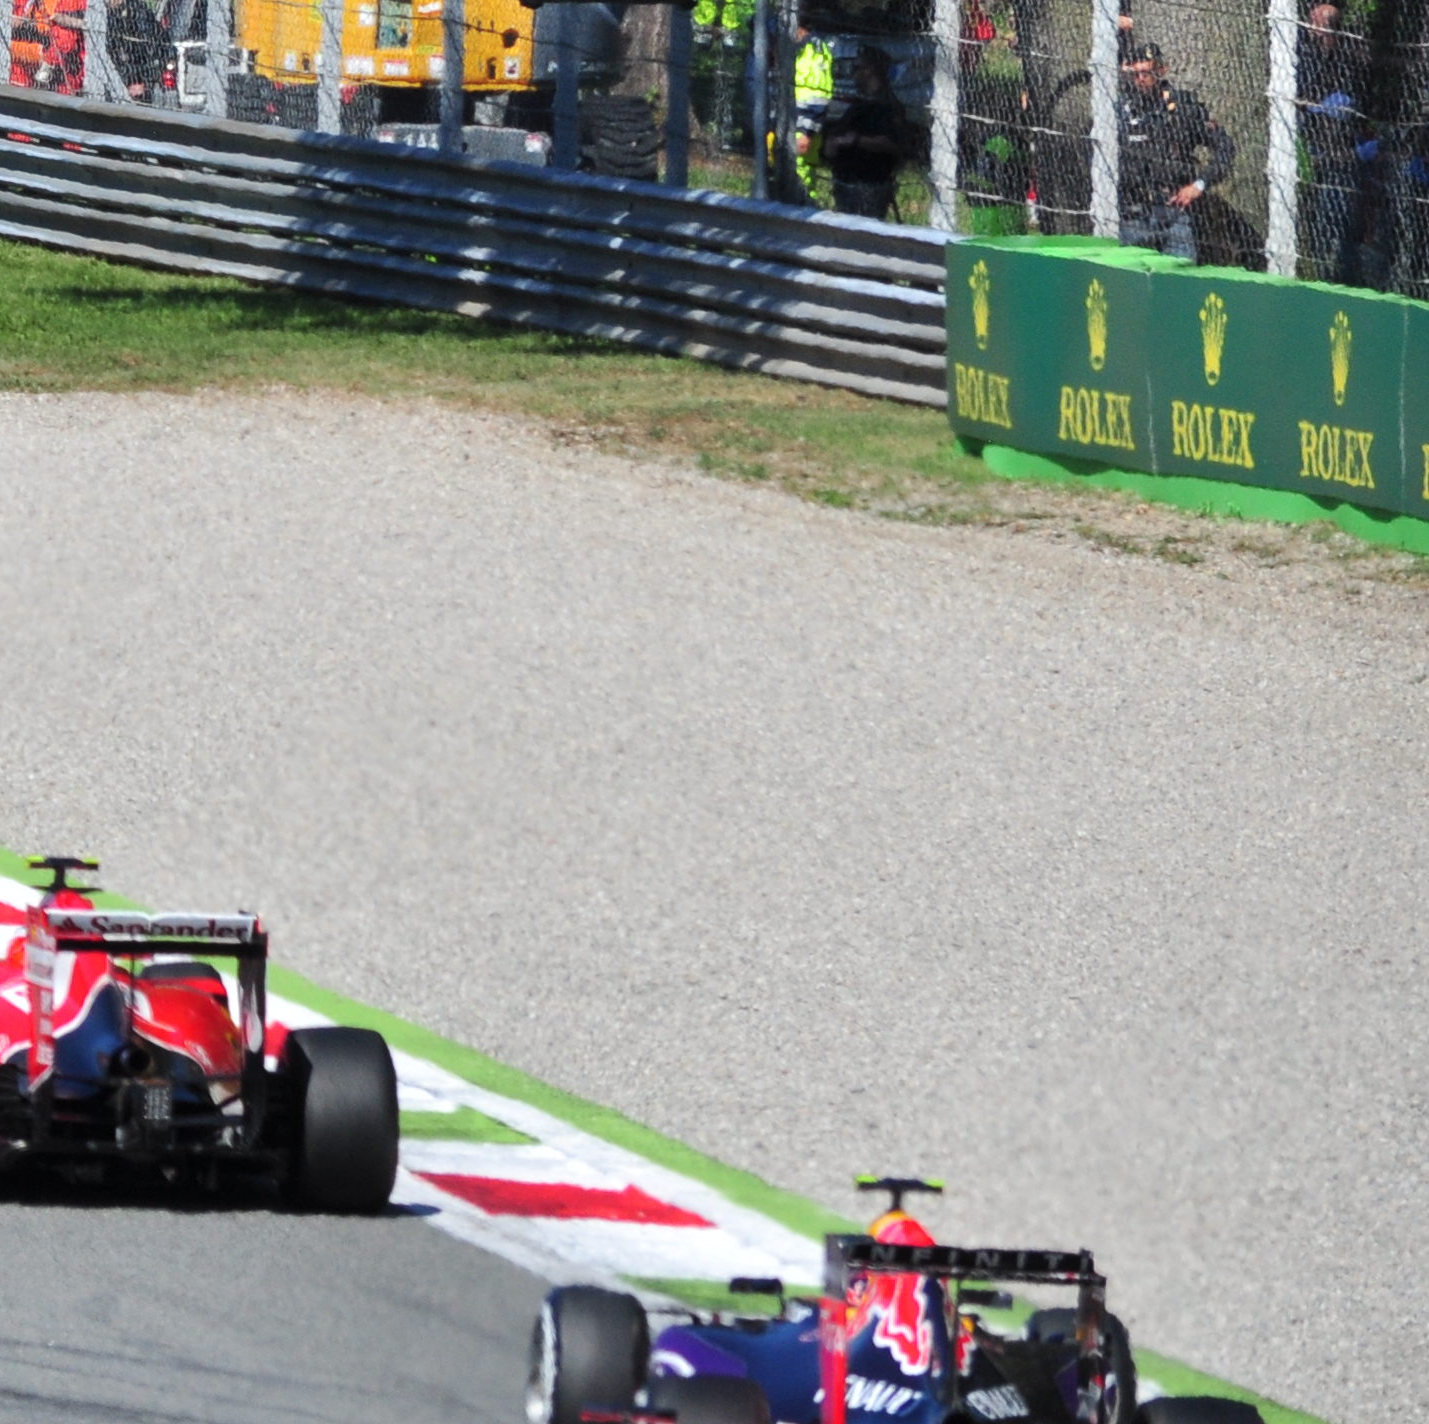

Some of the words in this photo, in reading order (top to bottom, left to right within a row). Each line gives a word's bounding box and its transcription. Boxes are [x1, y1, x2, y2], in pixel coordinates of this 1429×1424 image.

[953, 361, 1013, 430] ROLEX
[1058, 385, 1137, 452] ROLEX
[1171, 399, 1255, 470] ROLEX
[1298, 420, 1376, 489] ROLEX
[91, 916, 249, 939] Santander
